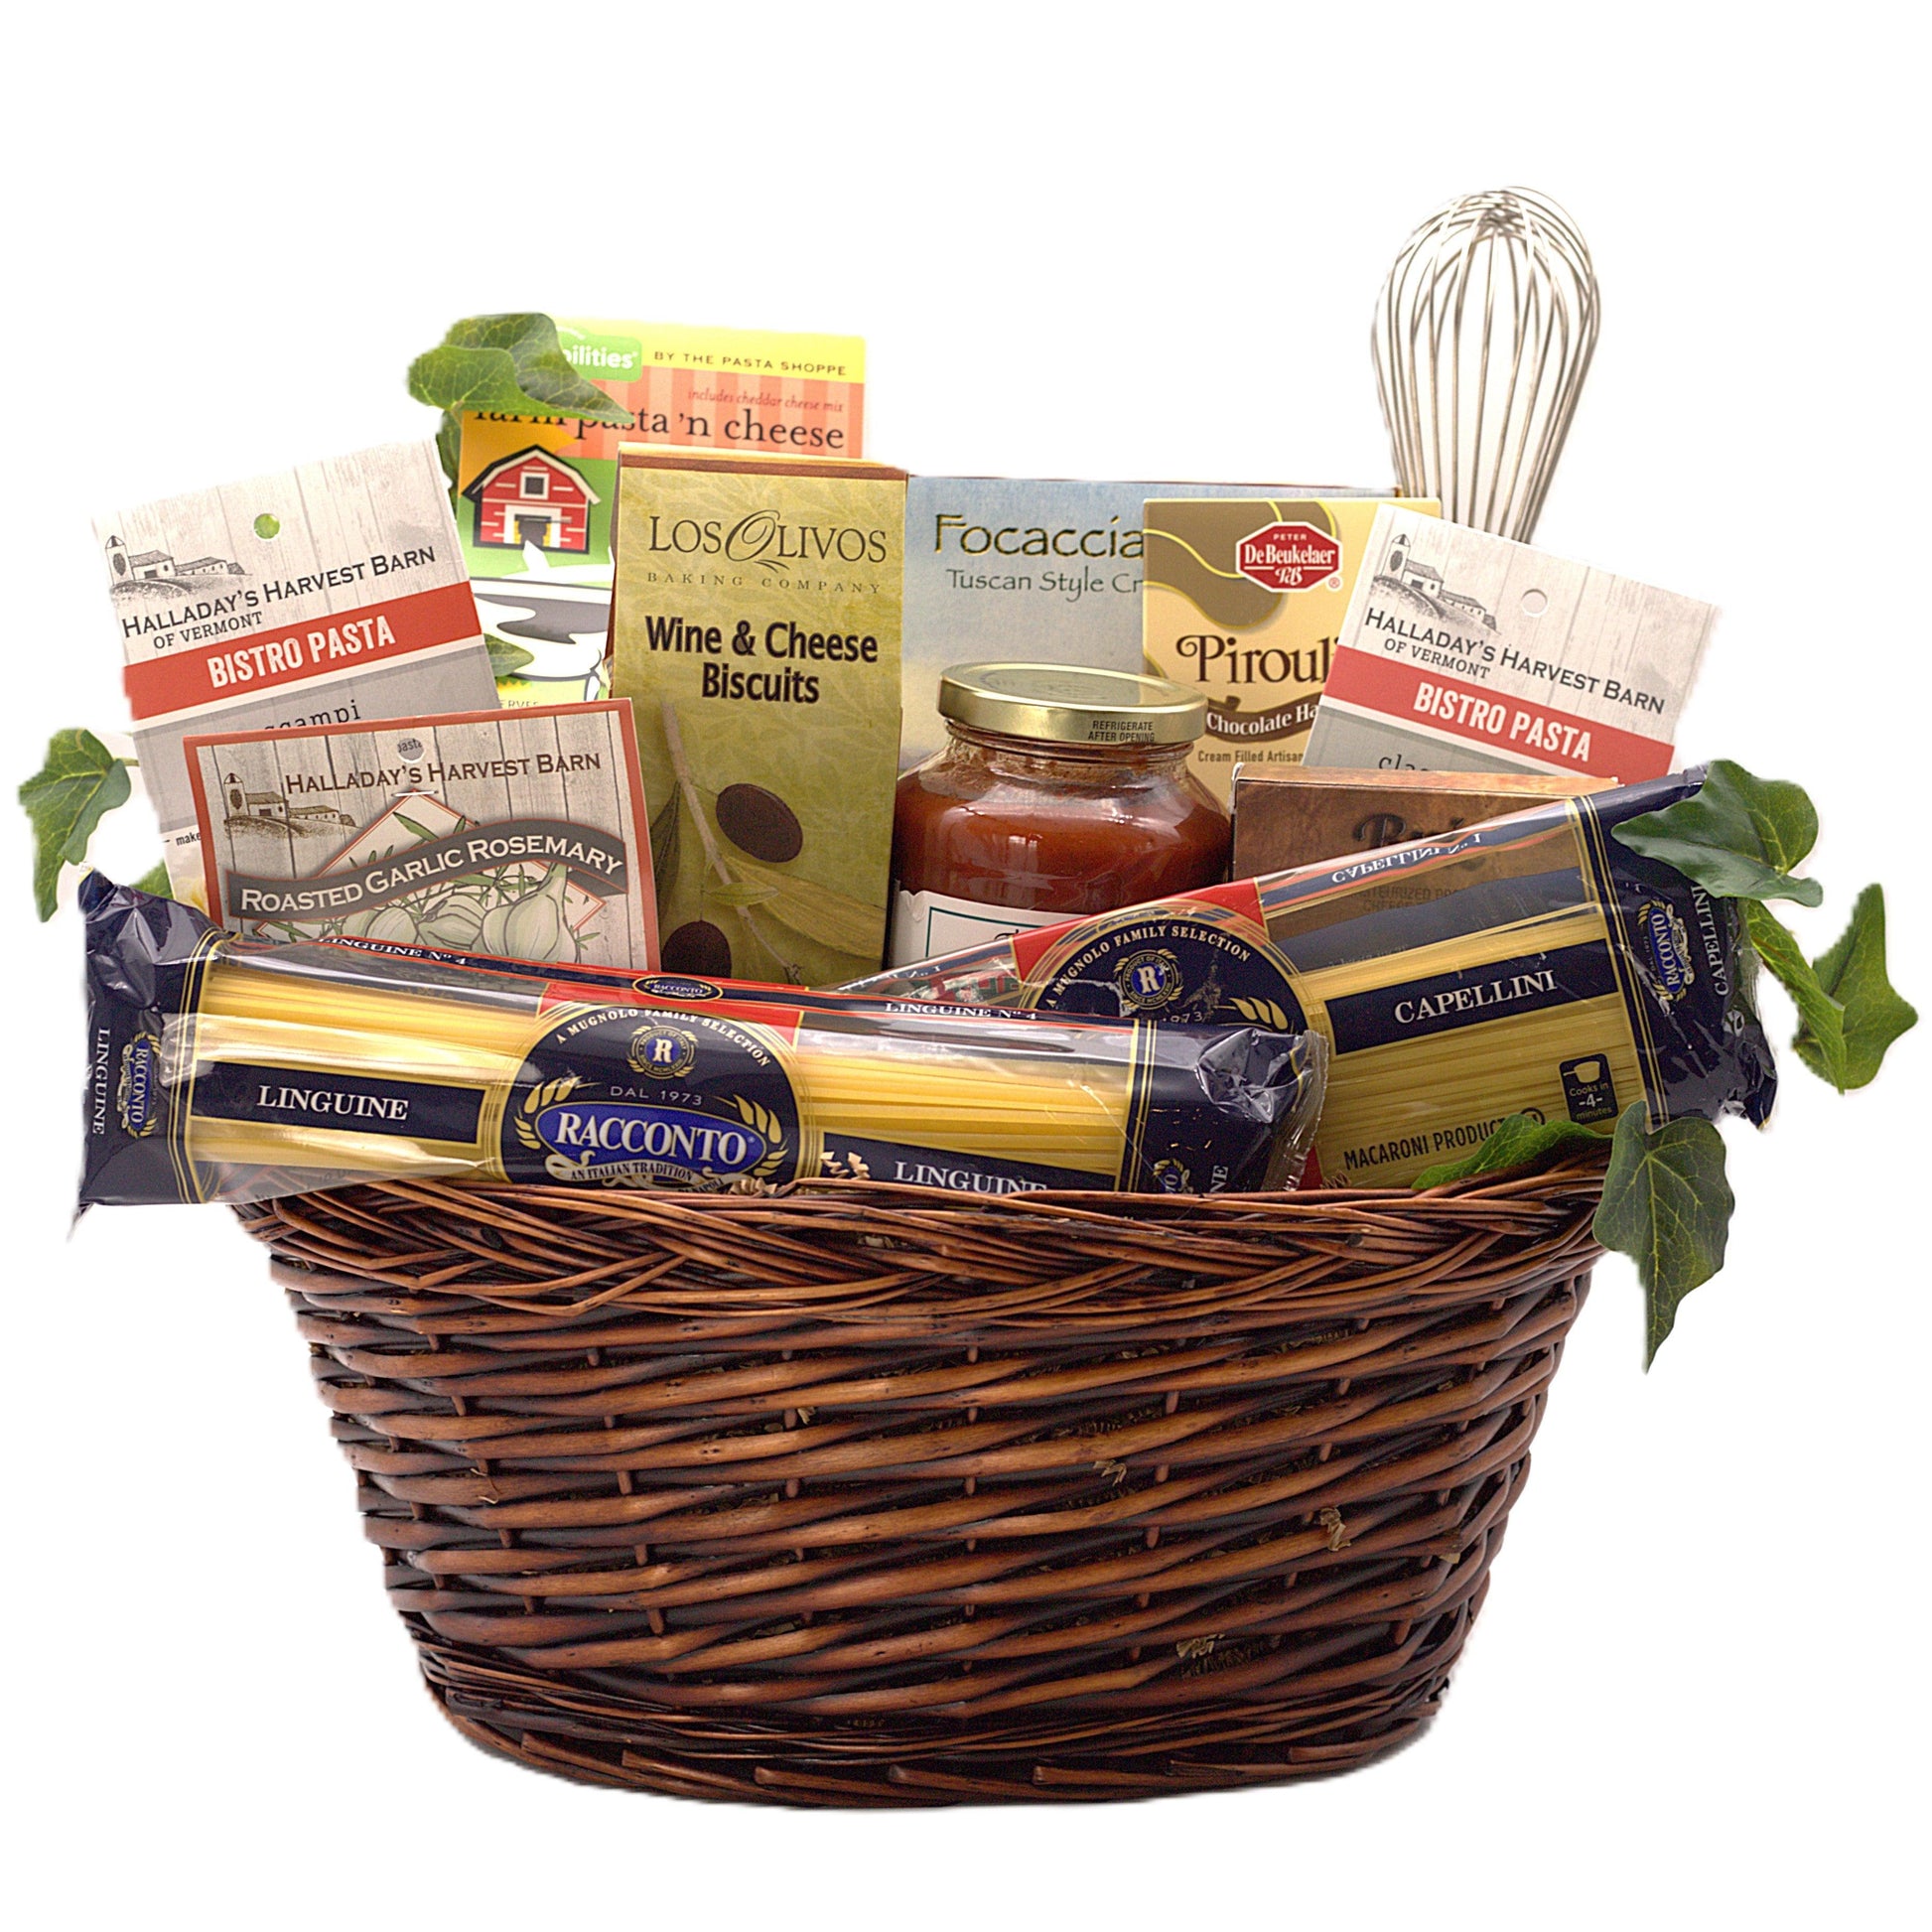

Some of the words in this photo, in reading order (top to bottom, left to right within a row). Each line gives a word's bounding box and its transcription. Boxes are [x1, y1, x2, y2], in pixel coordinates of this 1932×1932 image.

[654, 351, 674, 361] BY
[683, 353, 714, 364] THE
[723, 356, 773, 369] PASTA
[780, 361, 847, 376] SHOPPE
[688, 387, 734, 404] includes
[736, 391, 783, 406] cheddar
[784, 395, 820, 410] cheese
[823, 400, 844, 412] mix
[679, 413, 711, 437] 'n
[724, 408, 844, 450] cheese
[934, 513, 1144, 559] Focaccia
[122, 590, 260, 638] HALLADAY'S
[263, 562, 366, 604] HARVEST
[369, 545, 437, 577] BARN
[647, 572, 743, 587] BAKING
[761, 578, 882, 595] COMPANY
[947, 568, 1033, 593] Tuscan
[1038, 565, 1105, 603] Style
[153, 632, 176, 650] OF
[180, 611, 263, 643] VERMONT
[645, 616, 722, 654] Wine
[732, 620, 757, 656] &
[764, 621, 879, 663] Cheese
[207, 635, 305, 690] BISTRO
[309, 615, 396, 663] PASTA
[1364, 606, 1495, 662] HALLADAY'S
[1500, 646, 1600, 694] HARVEST
[1602, 682, 1666, 716] BARN
[1384, 637, 1408, 656] OF
[1412, 645, 1490, 680] VERMONT
[702, 662, 820, 705] Biscuits
[1088, 732, 1117, 743] AFTER
[1119, 733, 1155, 743] OPENING
[1092, 720, 1154, 732] REFRIGERATE
[1206, 711, 1292, 737] Chocolate
[1413, 681, 1506, 736] BISTRO
[1509, 710, 1592, 762] PASTA
[286, 764, 424, 795] HALLADAY'S
[428, 756, 531, 784] HARVEST
[537, 752, 602, 774] BARN
[1197, 751, 1231, 762] Cream
[1235, 751, 1263, 762] Filled
[240, 881, 363, 912] ROASTED
[364, 848, 465, 893] GARLIC
[468, 834, 625, 876] ROSEMARY
[1650, 912, 1682, 986] RACCONTO
[1690, 885, 1729, 996] CAPELLINI
[455, 956, 467, 965] 4
[1046, 996, 1057, 1008] A
[1053, 943, 1112, 993] MUGNOLO
[1113, 924, 1167, 948] FAMILY
[1171, 925, 1251, 963] SELECTION
[1137, 966, 1162, 994] R
[653, 983, 703, 994] RACCONTO
[1394, 968, 1557, 1025] CAPELLINI
[885, 1002, 991, 1018] LINGUINE
[555, 1032, 568, 1044] A
[569, 1008, 639, 1037] MUGNOLO
[644, 1010, 699, 1023] FAMILY
[701, 1017, 771, 1068] SELECTION
[652, 1038, 673, 1063] R
[92, 1028, 111, 1135] LINGUINE
[130, 1047, 149, 1124] RACCONTO
[610, 1085, 649, 1099] DAL
[659, 1088, 703, 1106] 1973
[1570, 1083, 1598, 1097] Cooks
[1599, 1081, 1608, 1091] in
[256, 1085, 409, 1121] LINGUINE
[1577, 1106, 1612, 1121] minutes
[553, 1112, 748, 1166] RACCONTO
[1344, 1135, 1431, 1172] MACARONI
[571, 1170, 586, 1181] AN
[587, 1163, 630, 1178] ITALIAN
[632, 1162, 693, 1181] TRADITION
